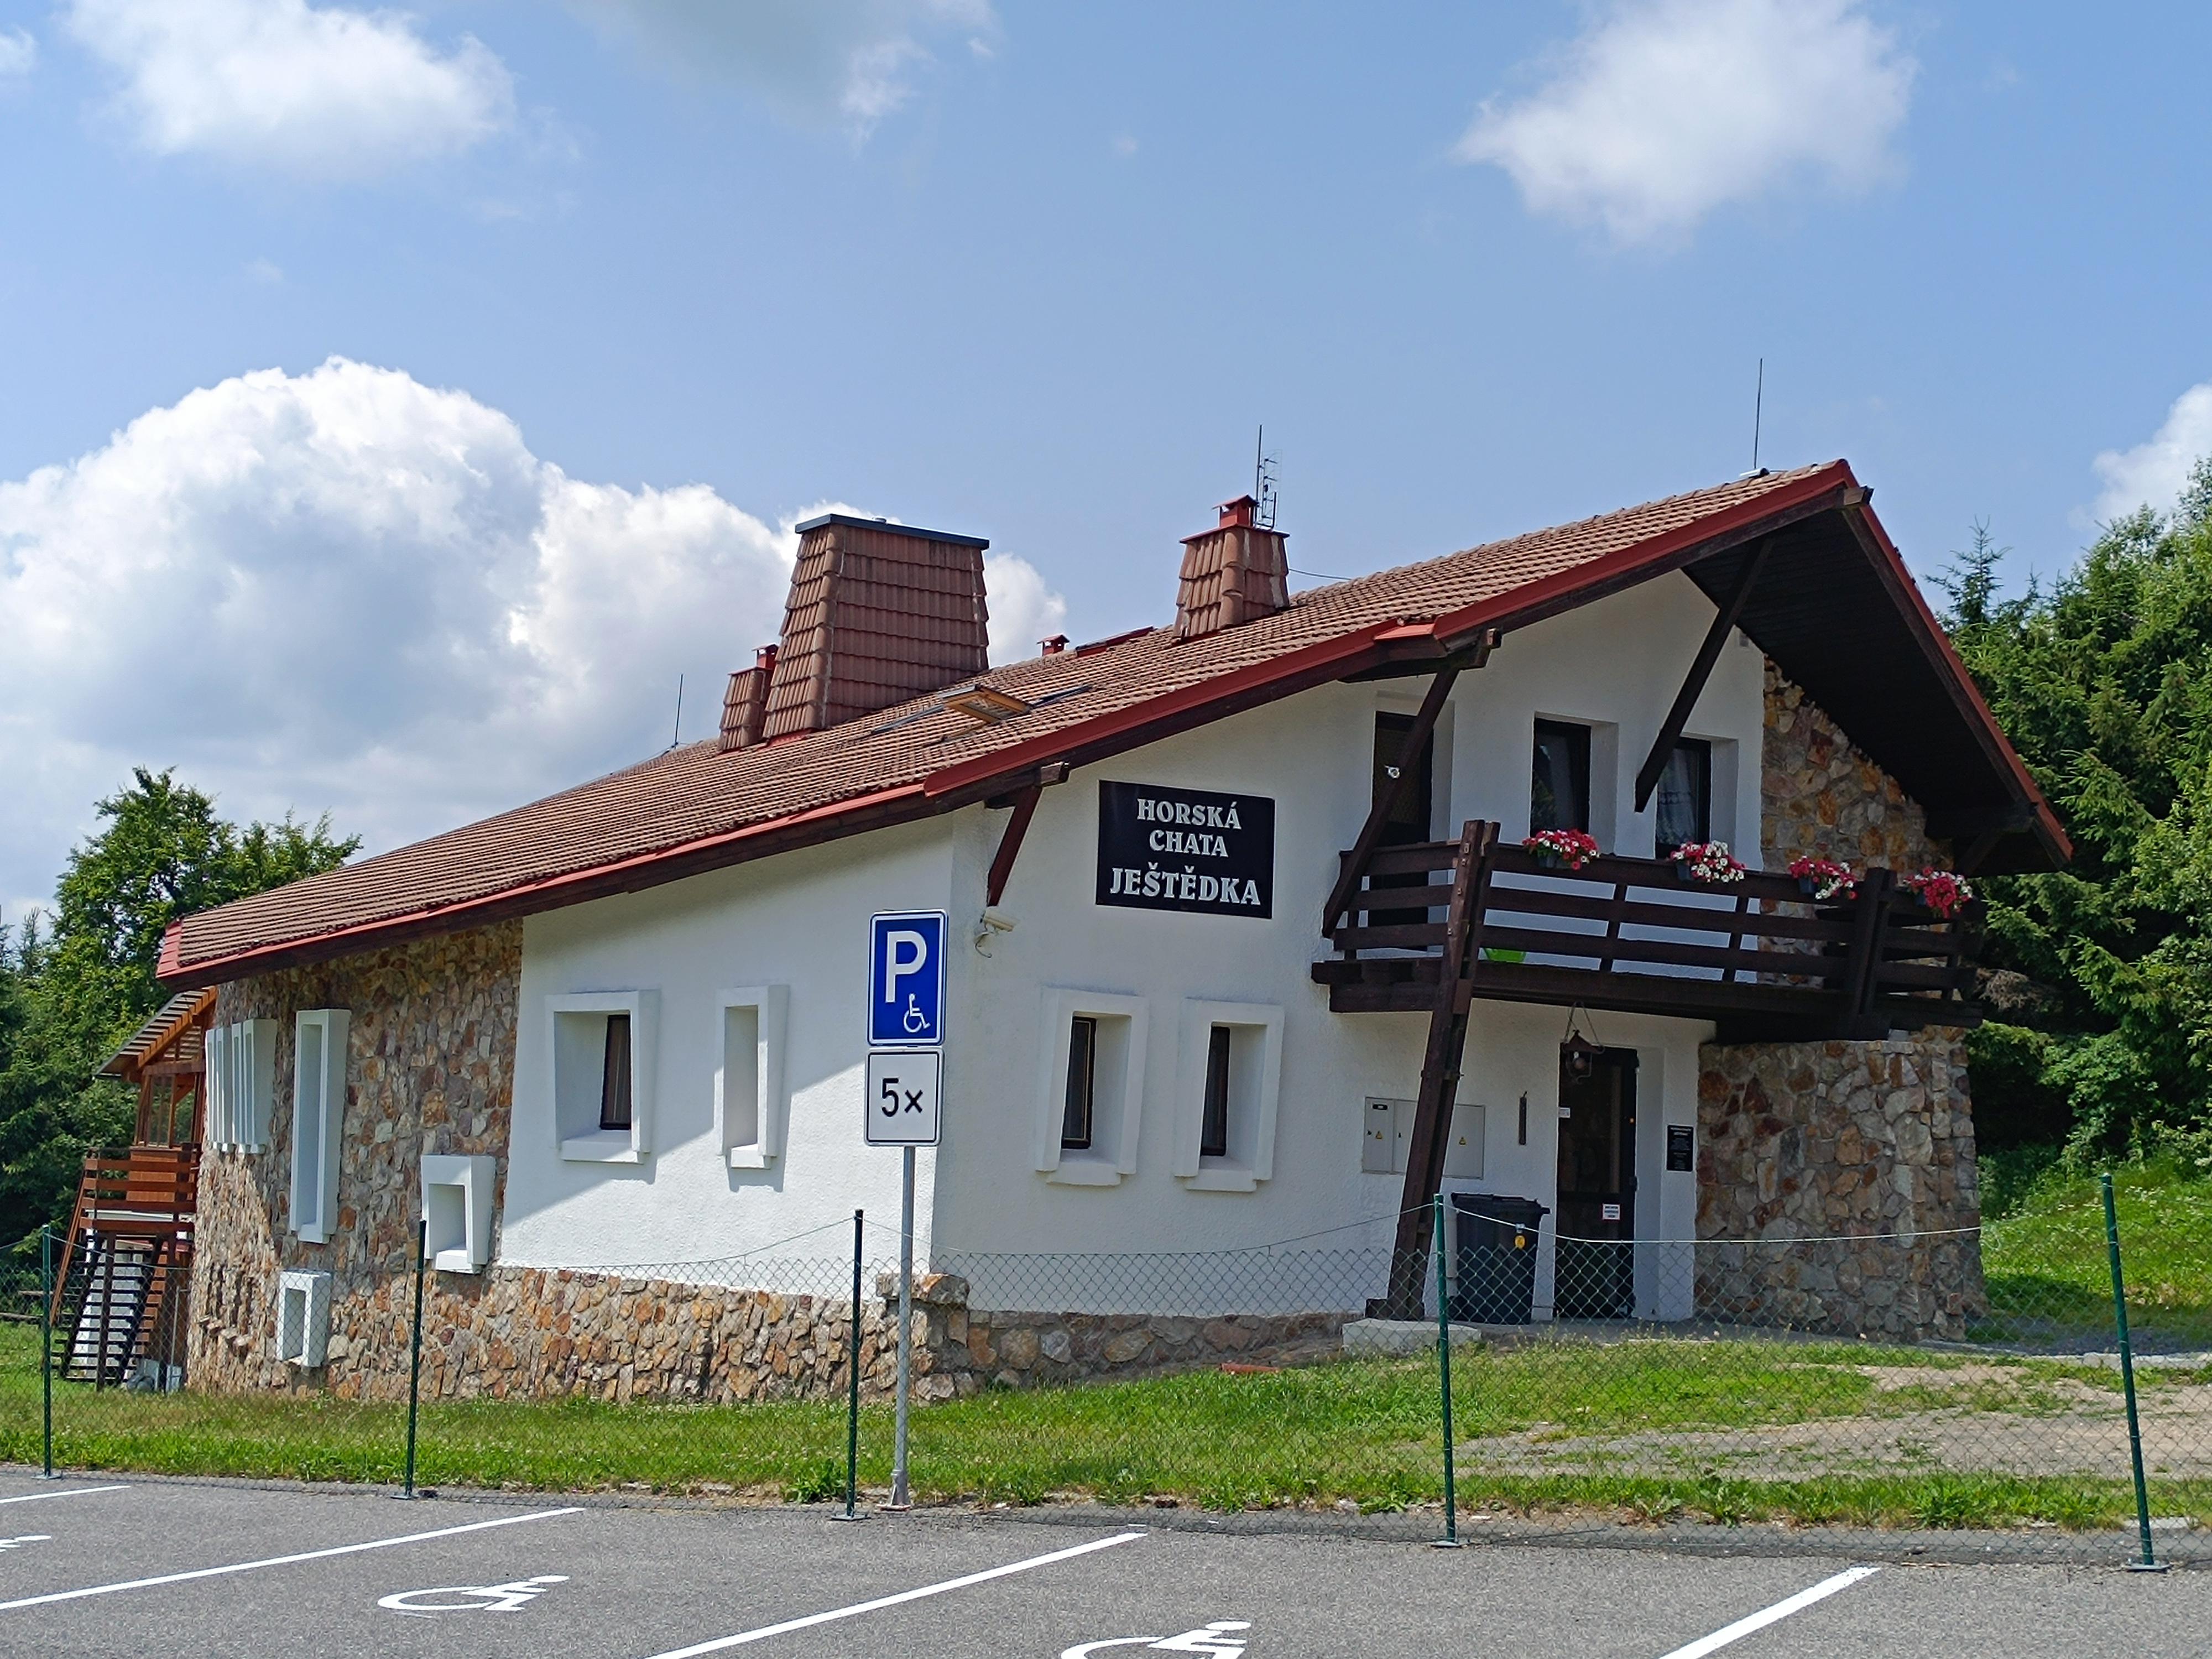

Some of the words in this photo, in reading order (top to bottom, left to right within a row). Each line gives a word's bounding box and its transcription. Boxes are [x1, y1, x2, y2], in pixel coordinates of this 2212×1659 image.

[1136, 799, 1242, 830] HORSKÁ
[1149, 829, 1229, 858] CHATA
[1109, 861, 1261, 906] JEŠTĚDKA
[885, 930, 927, 1003] P
